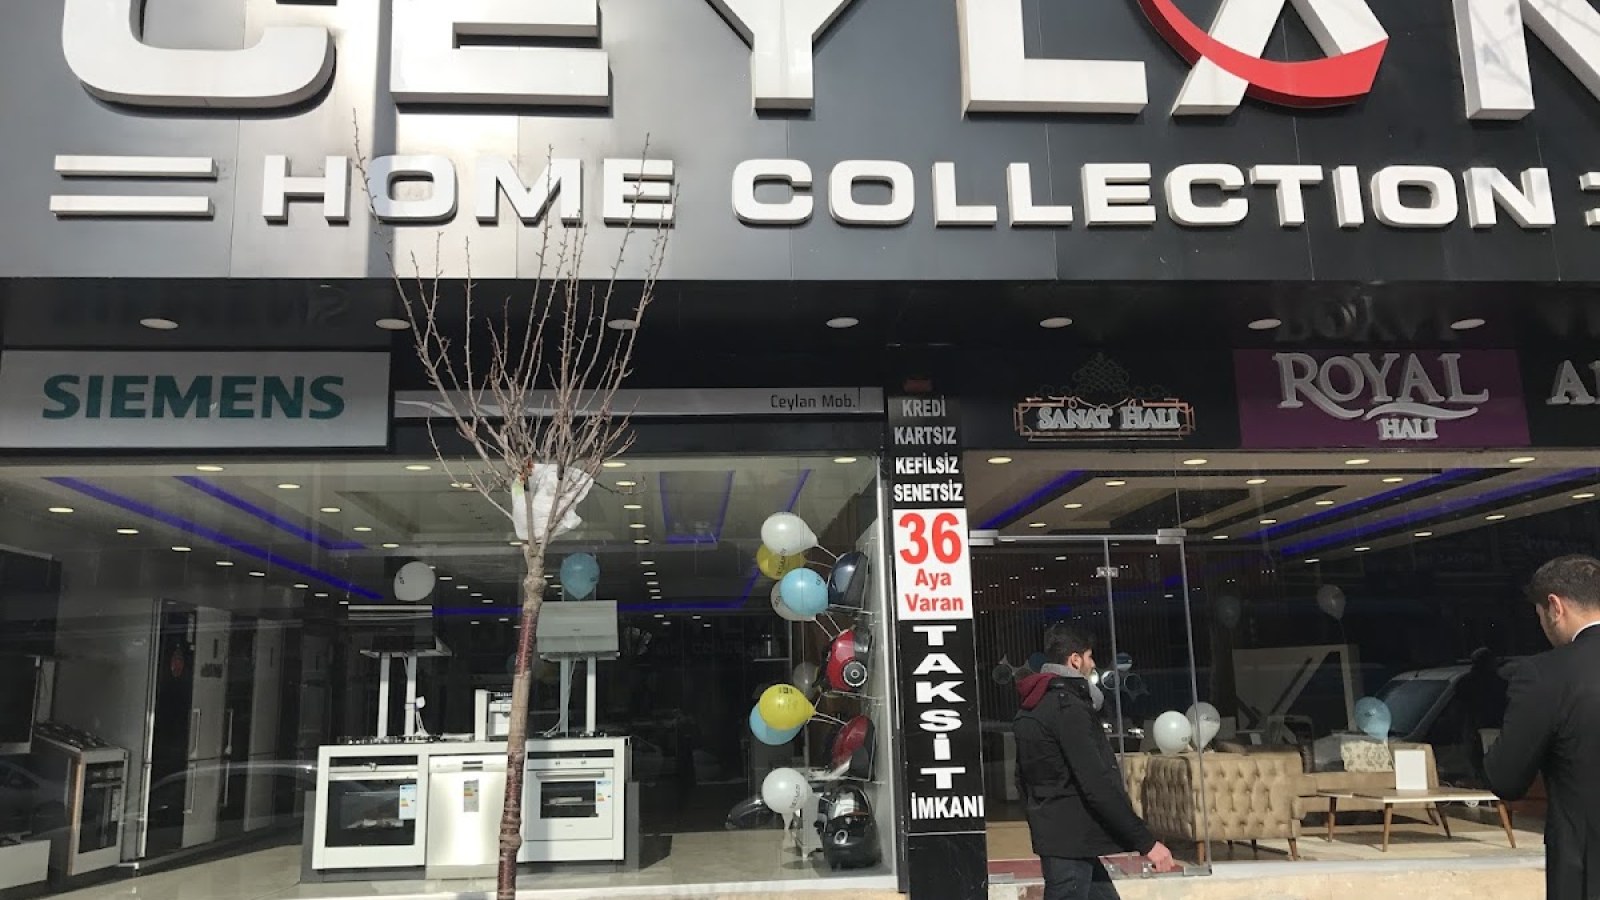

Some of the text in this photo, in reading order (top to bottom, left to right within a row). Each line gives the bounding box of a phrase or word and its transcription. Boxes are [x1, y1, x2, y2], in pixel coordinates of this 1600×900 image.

[262, 154, 1557, 229] HOME COLLECTION
[42, 374, 346, 420] SIEMENS
[1271, 352, 1489, 419] ROYAL
[770, 394, 856, 410] Ceylan Mob.
[902, 395, 946, 417] KREDİ
[1037, 406, 1180, 429] SANAT HALI
[1376, 418, 1438, 440] HALI
[893, 426, 957, 445] KARTSIZ
[895, 452, 959, 475] KEFİLSİZ
[893, 479, 964, 502] SENETSİZ
[899, 512, 962, 564] 36
[915, 568, 952, 590] Aya
[904, 593, 964, 612] Varan
[912, 625, 967, 789] TAKSİT
[911, 792, 985, 820] İMKANI
